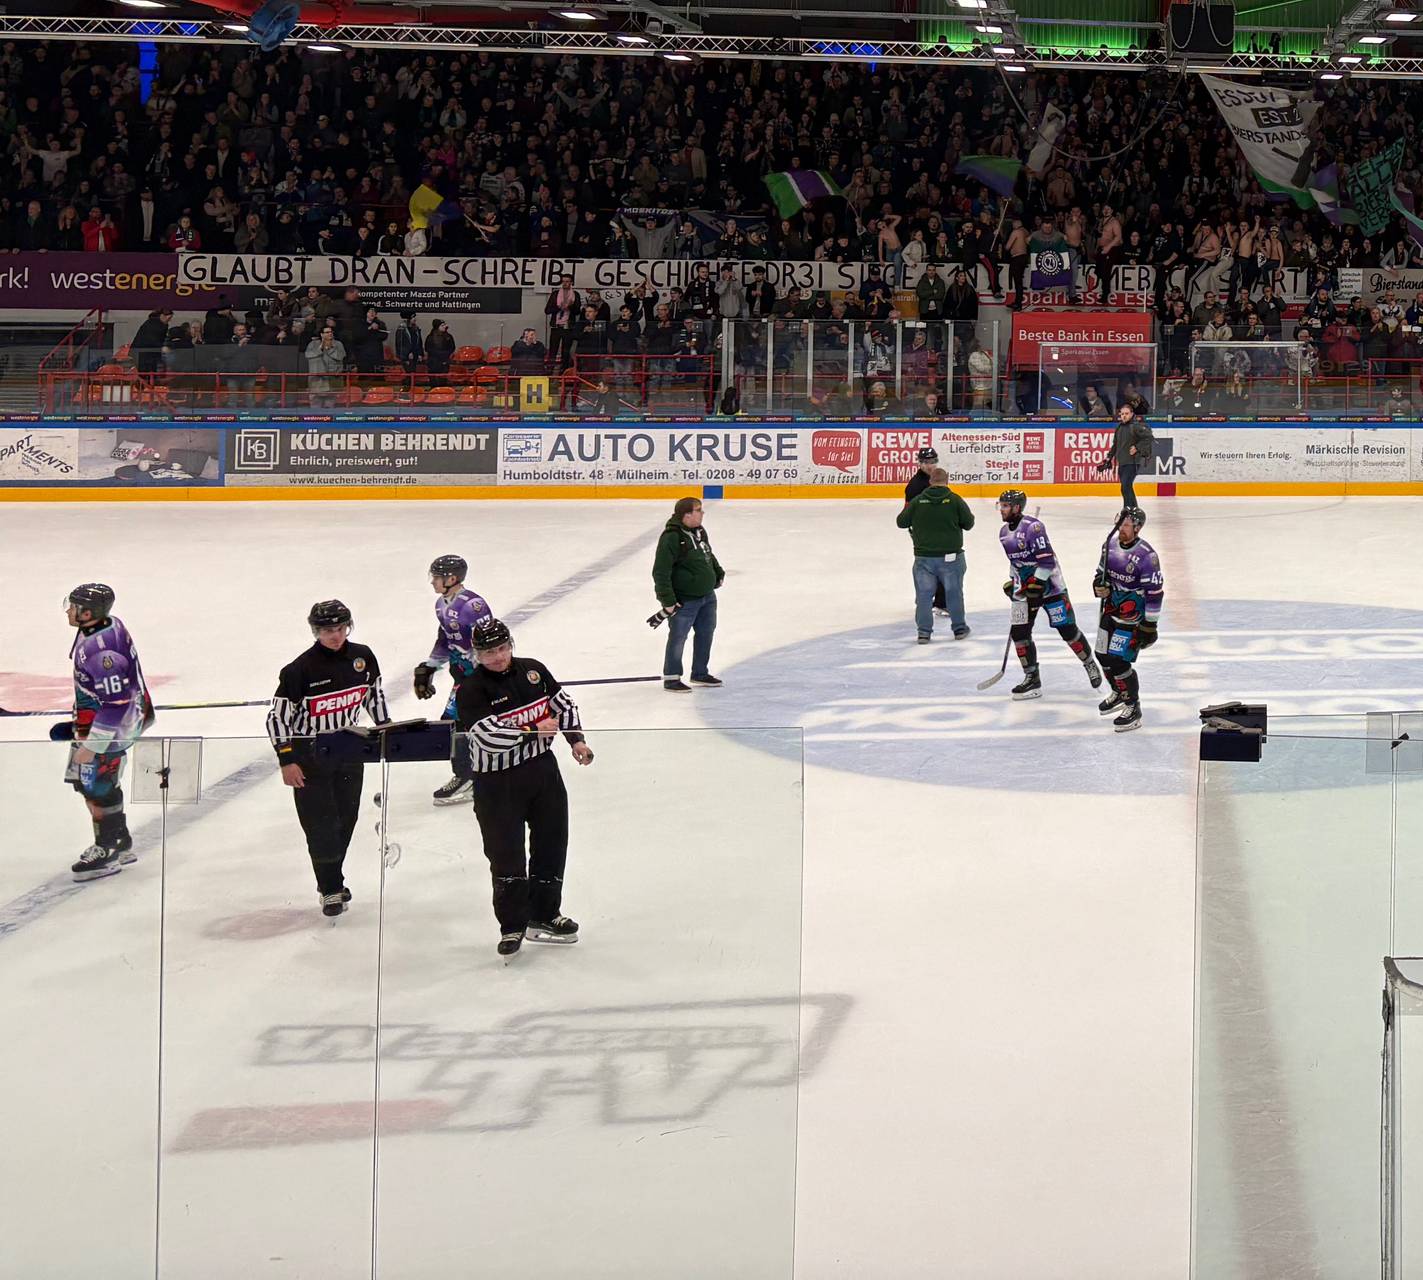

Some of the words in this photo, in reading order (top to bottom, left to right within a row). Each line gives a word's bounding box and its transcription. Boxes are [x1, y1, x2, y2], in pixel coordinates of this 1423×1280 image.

[183, 255, 312, 284] GLAUBT
[50, 268, 216, 297] westener
[439, 291, 469, 299] Partner
[442, 301, 481, 309] Hattingen
[1019, 330, 1054, 342] Beste
[1058, 330, 1089, 342] Bank
[1092, 330, 1104, 342] in
[1107, 330, 1144, 342] Essen
[526, 383, 543, 404] H
[290, 429, 376, 451] KÜCHEN
[380, 433, 490, 451] BEHRENDT
[813, 437, 830, 448] VOM
[871, 432, 930, 449] REWE
[941, 432, 1021, 442] Altenessen-Süd
[547, 433, 656, 462] AUTO
[668, 433, 799, 461] KRUSE
[1014, 444, 1021, 454] 3
[1306, 444, 1359, 455] Märkische
[1362, 445, 1406, 455] Revision
[290, 456, 333, 467] Ehrlich,
[335, 456, 393, 468] preiswert,
[395, 456, 418, 467] gut!
[1268, 452, 1292, 461] Erfolg.
[1156, 456, 1186, 475] MR
[503, 469, 585, 480] Humboldtstr.
[589, 469, 604, 480] 48
[615, 468, 669, 480] Mülheim
[682, 469, 702, 480] Tel.
[706, 469, 735, 480] 0208
[747, 469, 761, 479] 49
[765, 469, 780, 479] 07
[783, 468, 798, 479] 69
[837, 473, 860, 484] Essen
[870, 466, 894, 482] DEIN
[897, 466, 920, 482] MAR
[949, 472, 983, 484] singer
[986, 472, 1002, 481] Tor
[1006, 472, 1019, 481] 14
[1063, 466, 1085, 482] DEIN
[288, 476, 417, 485] www.kuechen-behrendt.de
[102, 675, 122, 695] 16
[315, 691, 362, 714] PENNY
